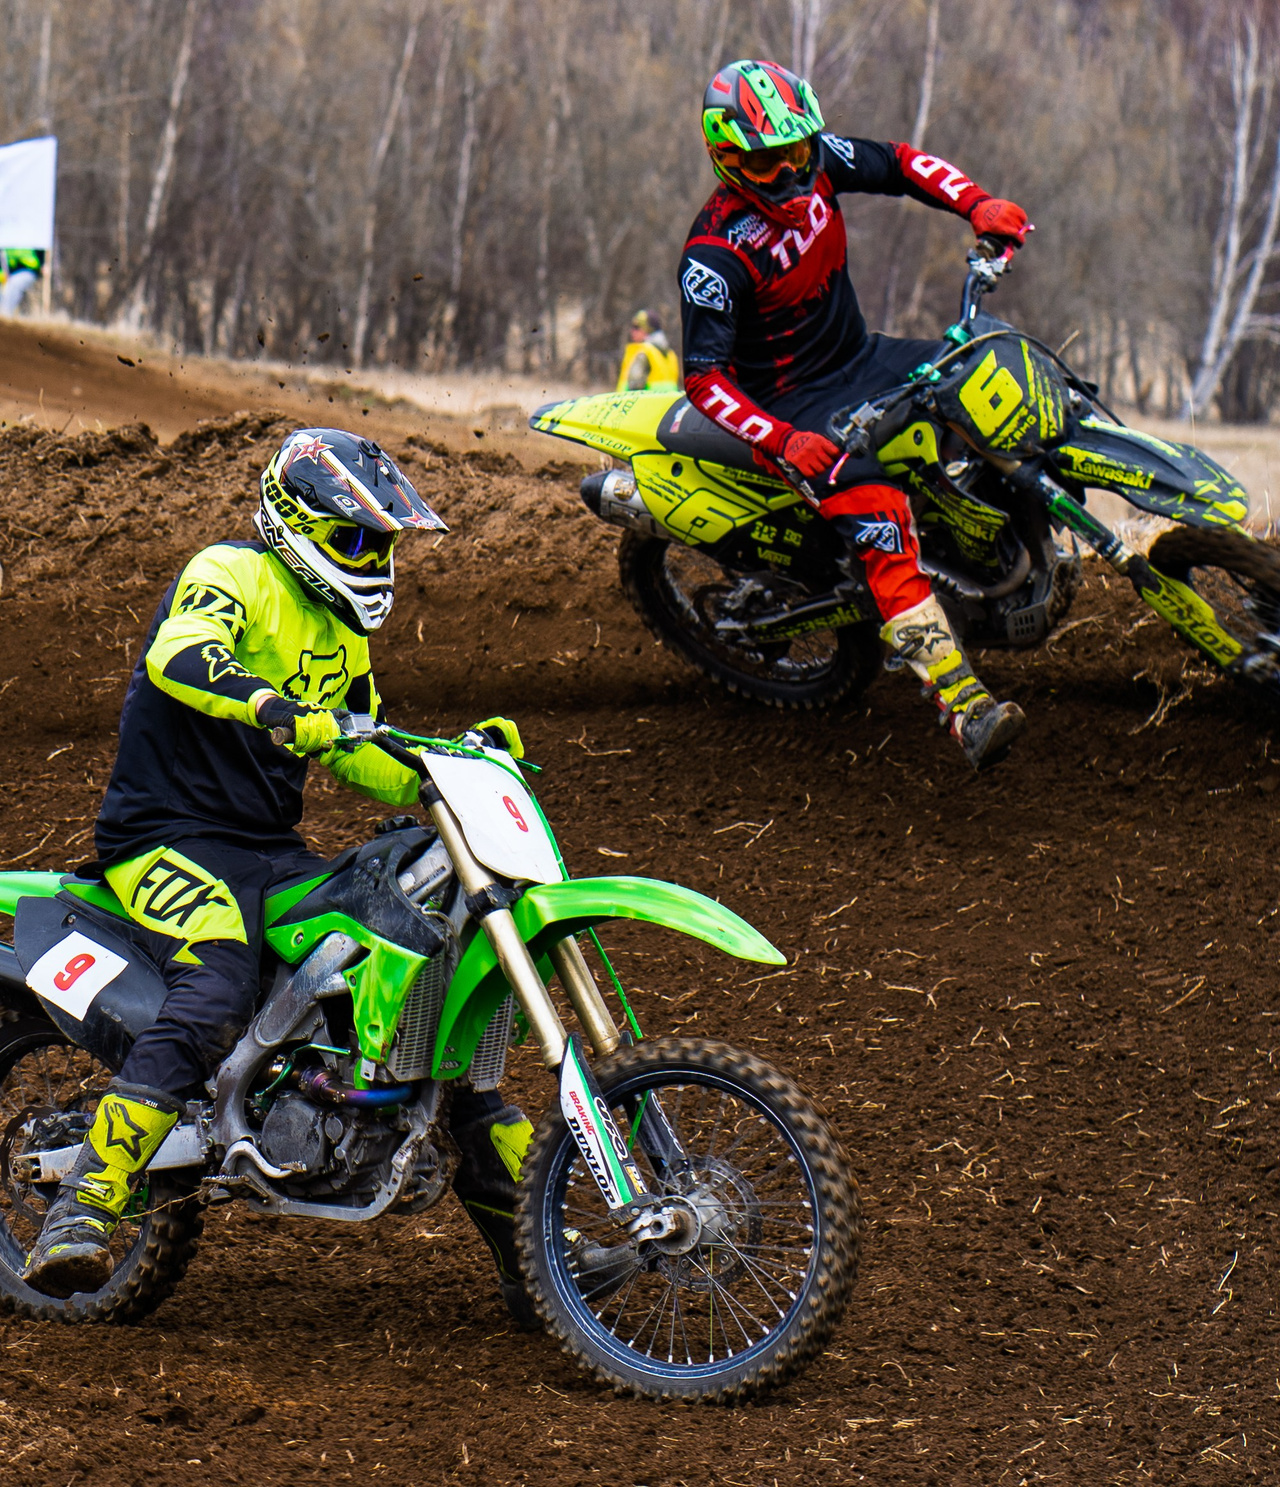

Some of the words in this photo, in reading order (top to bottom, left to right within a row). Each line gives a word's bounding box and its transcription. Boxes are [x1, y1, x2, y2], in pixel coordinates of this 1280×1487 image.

[959, 349, 1023, 437] 6
[581, 431, 632, 453] DUNLOP
[1071, 455, 1155, 490] Kawasaki
[264, 470, 318, 535] 100%
[757, 546, 792, 566] VANS
[502, 795, 529, 832] 9
[130, 857, 233, 929] FOX
[53, 953, 96, 992] 9
[569, 1091, 596, 1135] BRAKING
[593, 1096, 629, 1161] UFO
[567, 1116, 616, 1204] DUNLOP
